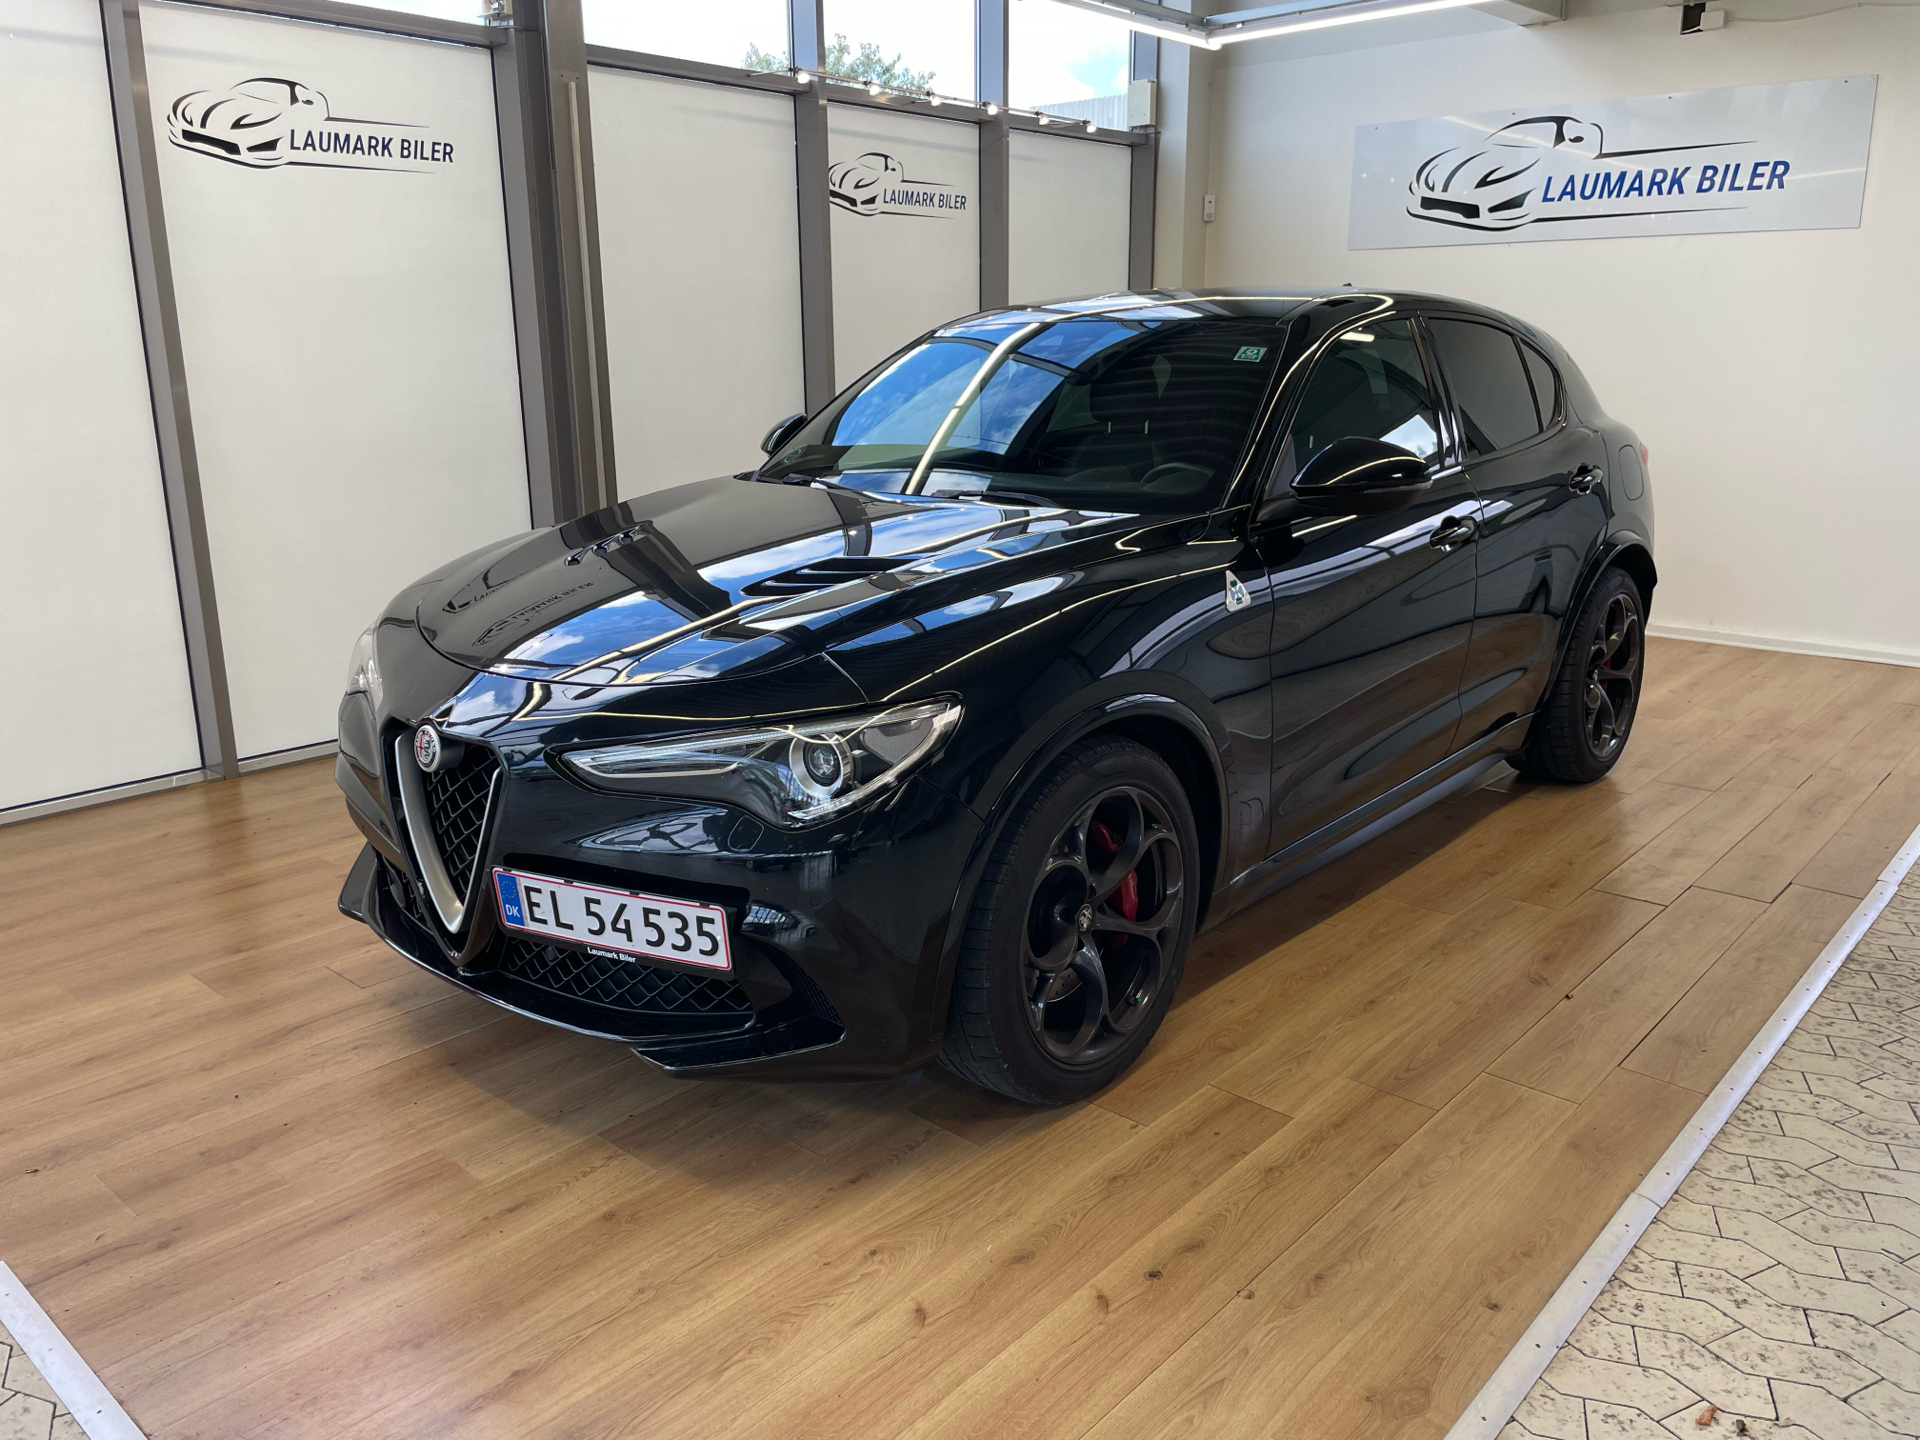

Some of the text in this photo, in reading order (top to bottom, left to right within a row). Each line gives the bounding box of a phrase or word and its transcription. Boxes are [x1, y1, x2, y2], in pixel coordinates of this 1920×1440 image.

[289, 129, 454, 163] LAUMARK BILER
[1541, 160, 1791, 203] LAUMARK BILER
[882, 188, 967, 210] LAUMARK BILER
[505, 904, 521, 918] DK
[523, 884, 574, 931] EL
[587, 946, 636, 963] Laumark Biler
